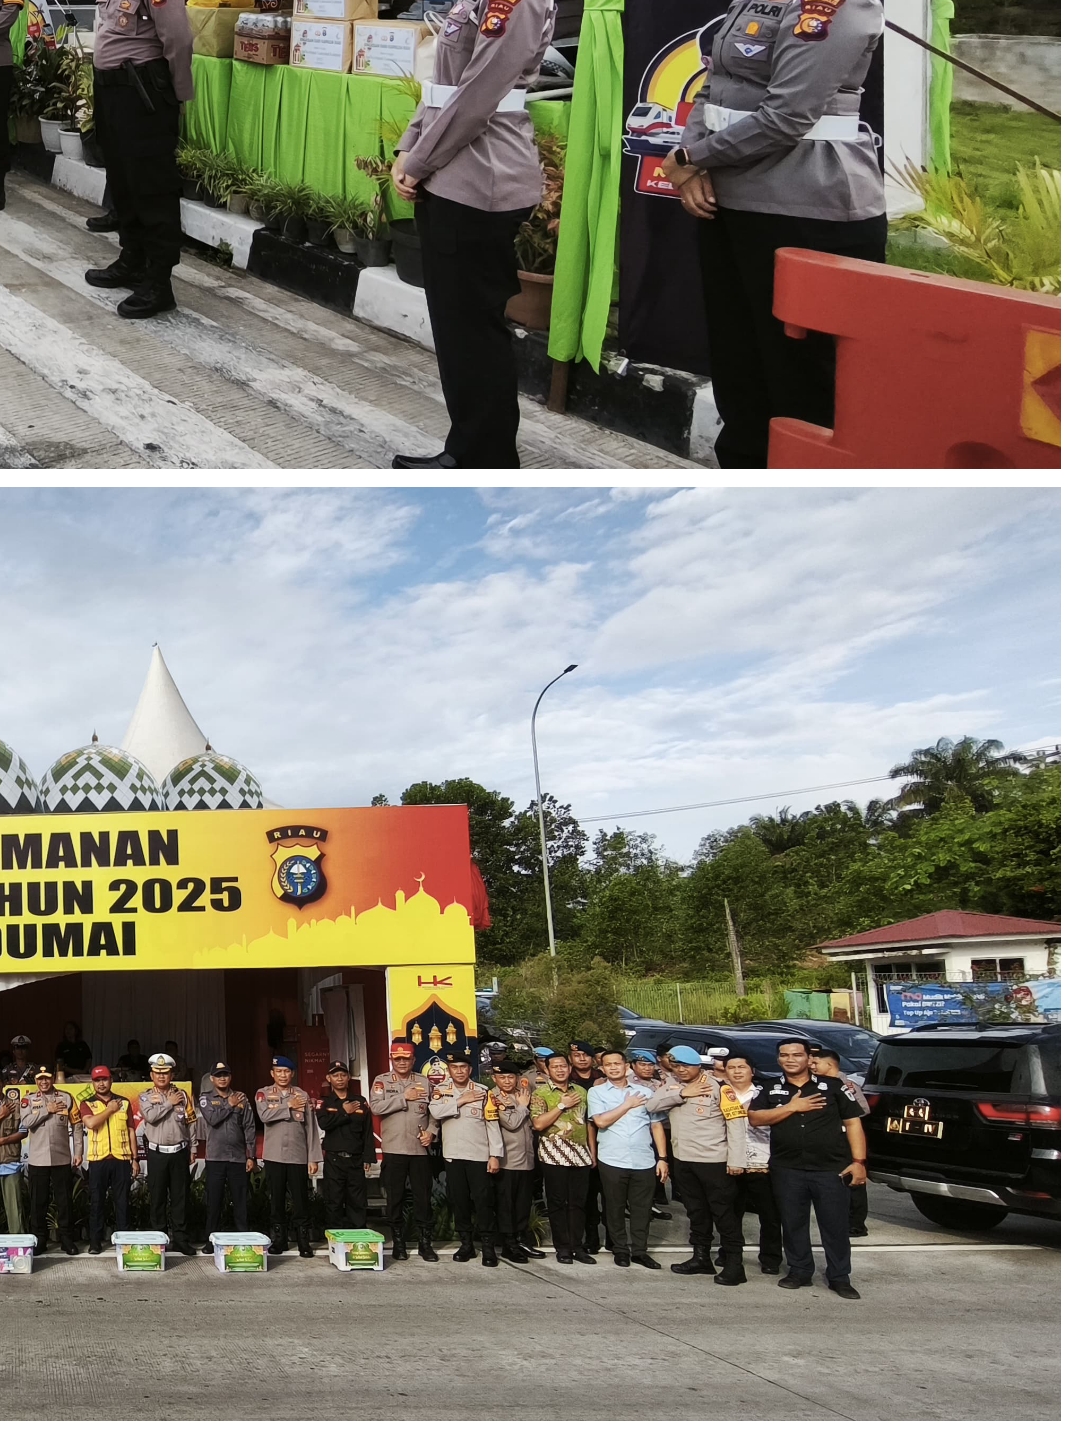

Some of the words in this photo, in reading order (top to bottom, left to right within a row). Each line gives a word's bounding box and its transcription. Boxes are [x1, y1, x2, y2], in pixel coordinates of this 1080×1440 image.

[746, 3, 783, 18] POLRI
[804, 4, 833, 13] RIAU
[273, 827, 322, 840] RIAU
[110, 876, 243, 914] 2025
